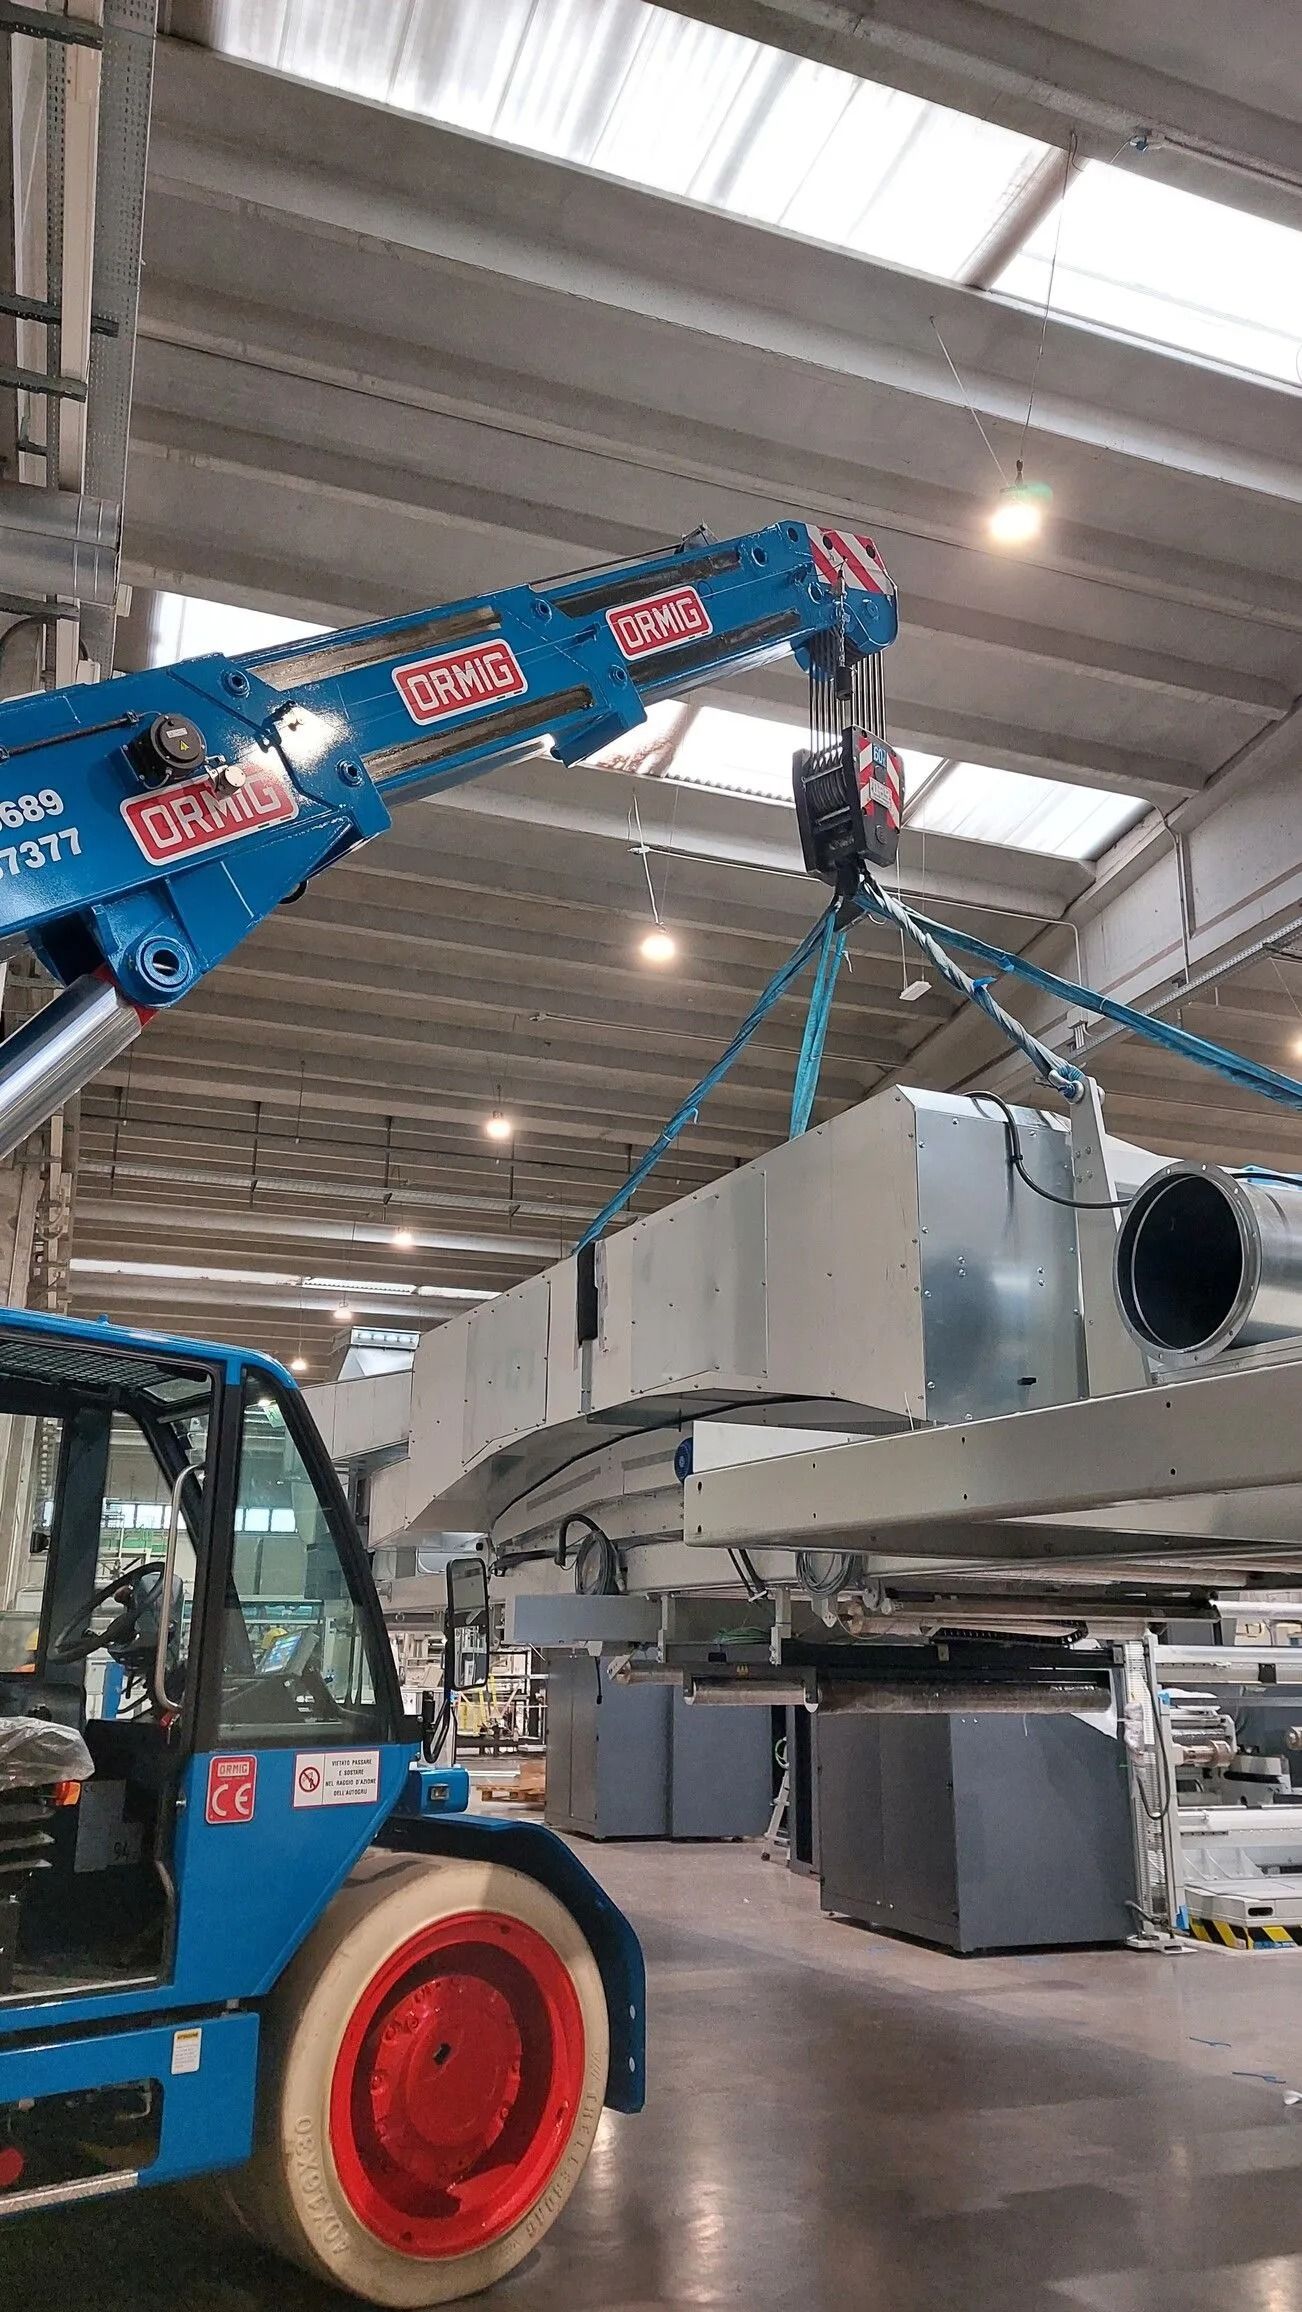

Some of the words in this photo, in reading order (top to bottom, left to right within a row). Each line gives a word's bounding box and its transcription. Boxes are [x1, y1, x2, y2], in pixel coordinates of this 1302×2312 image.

[617, 597, 702, 649] ORMIG
[406, 651, 515, 712] ORMIG
[0, 789, 64, 831] 689
[140, 776, 282, 849] ORMIG
[0, 827, 82, 880] 7377
[219, 1763, 248, 1775] ORMIG
[212, 1783, 252, 1817] CE
